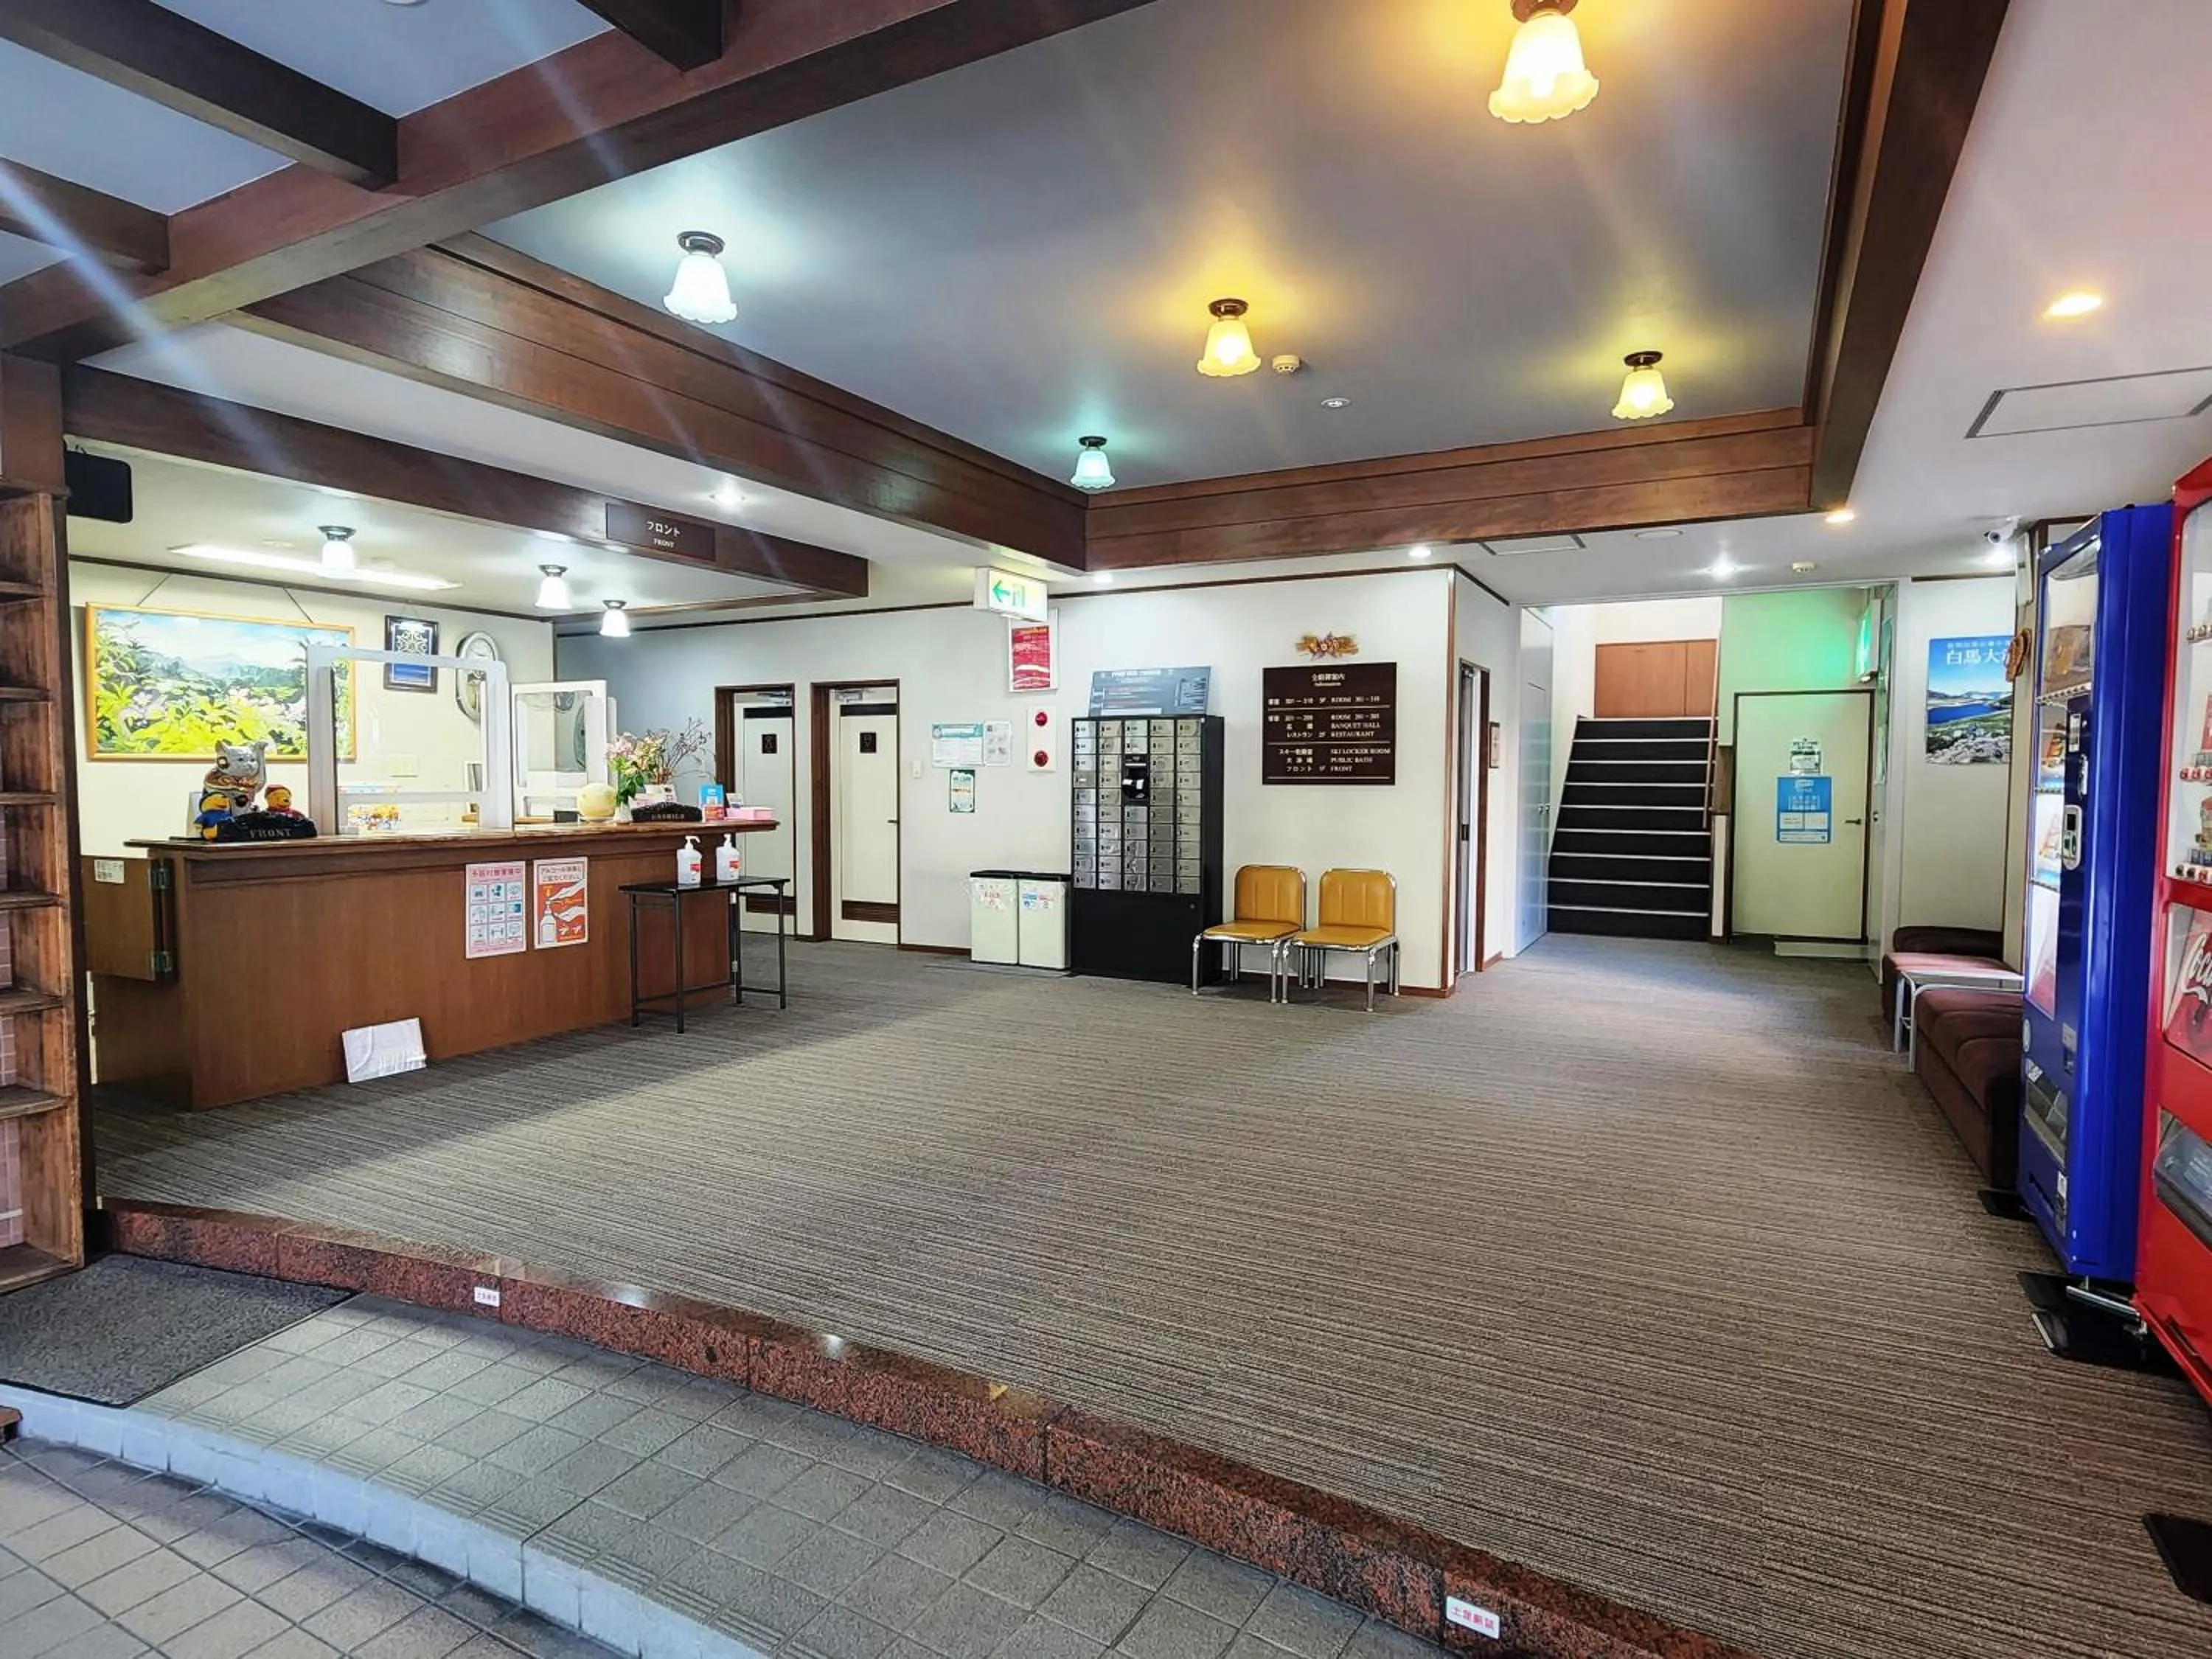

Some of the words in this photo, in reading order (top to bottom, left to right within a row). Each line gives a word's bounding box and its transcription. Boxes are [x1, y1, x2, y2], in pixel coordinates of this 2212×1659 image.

[647, 521, 681, 537] フロント
[1947, 649, 2006, 665] 白馬大
[249, 828, 292, 838] FRONT
